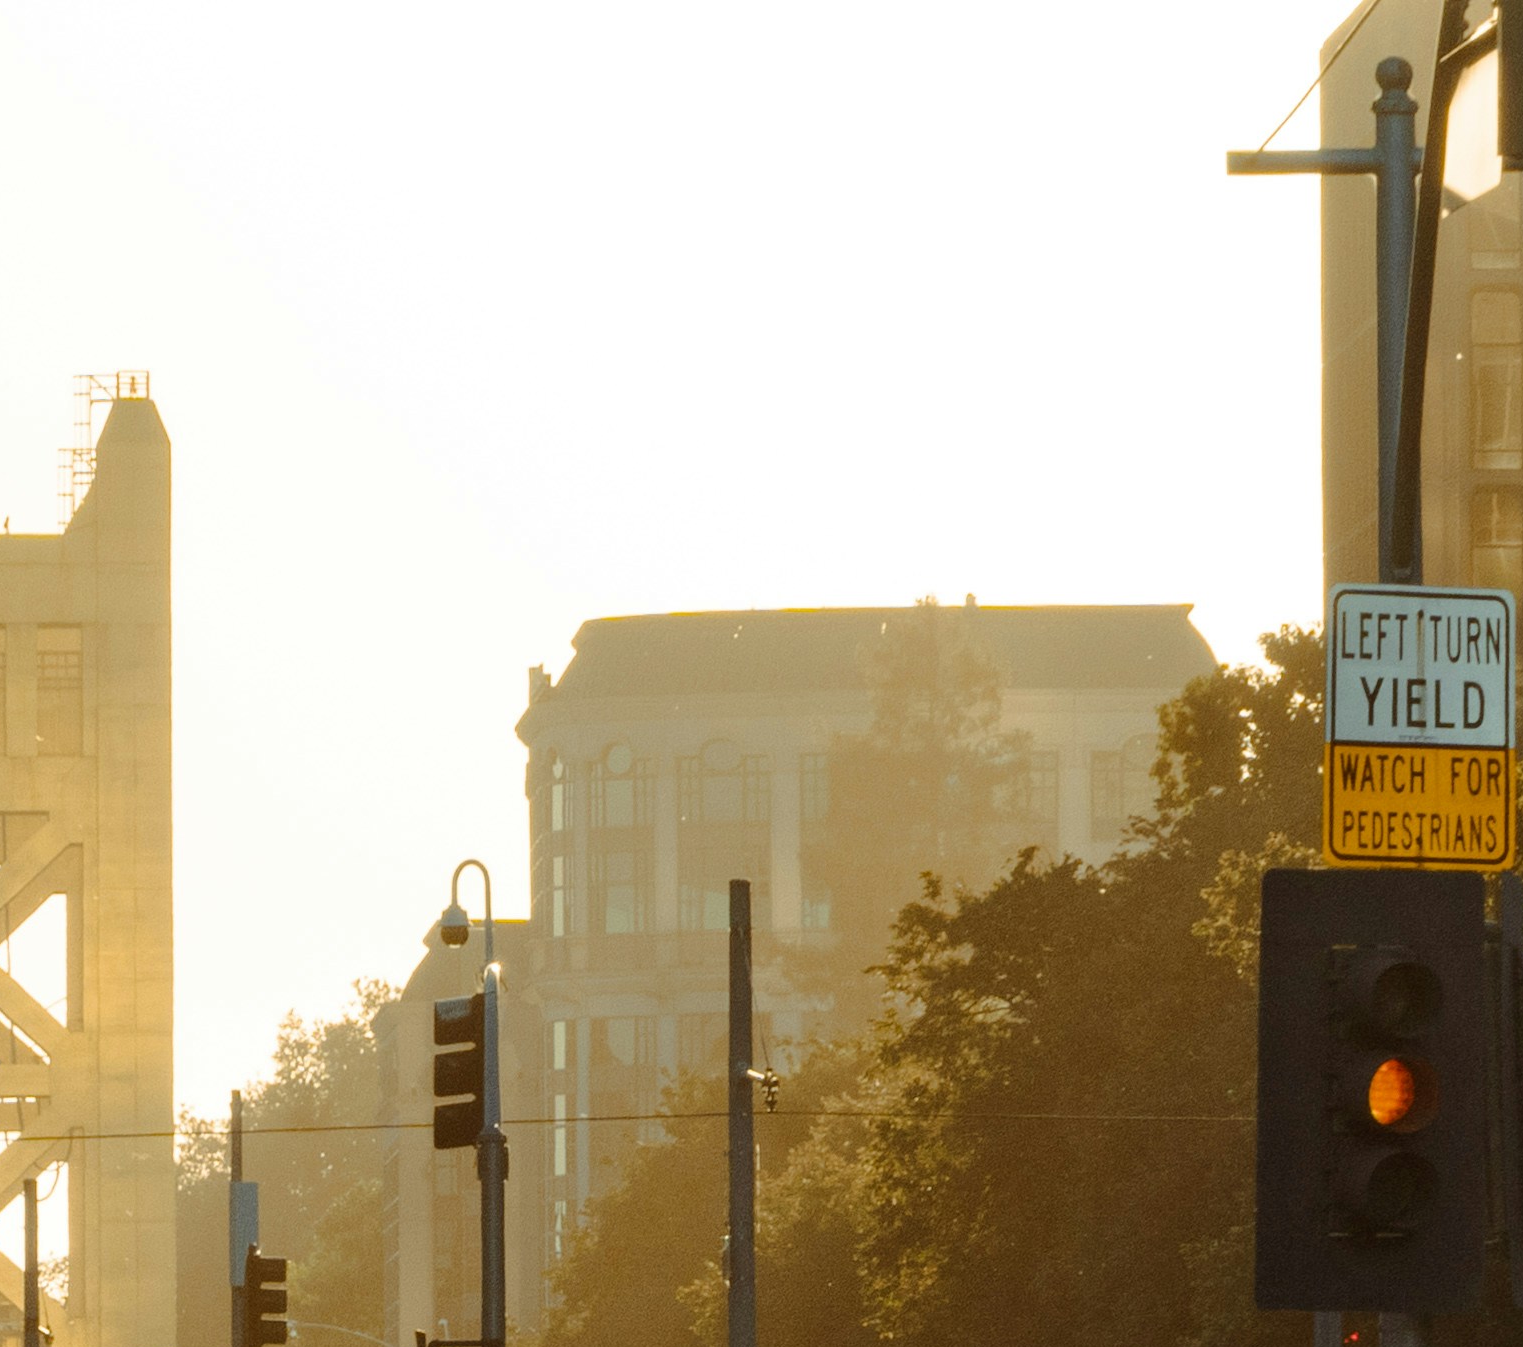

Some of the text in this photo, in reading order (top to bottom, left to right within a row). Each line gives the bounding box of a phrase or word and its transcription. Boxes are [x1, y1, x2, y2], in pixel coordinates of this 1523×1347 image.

[1341, 611, 1501, 664] LEFT TURN
[1361, 677, 1485, 729] YIELD
[1340, 753, 1501, 796] WATCH FOR
[1342, 810, 1497, 853] PEDESTRIANS
